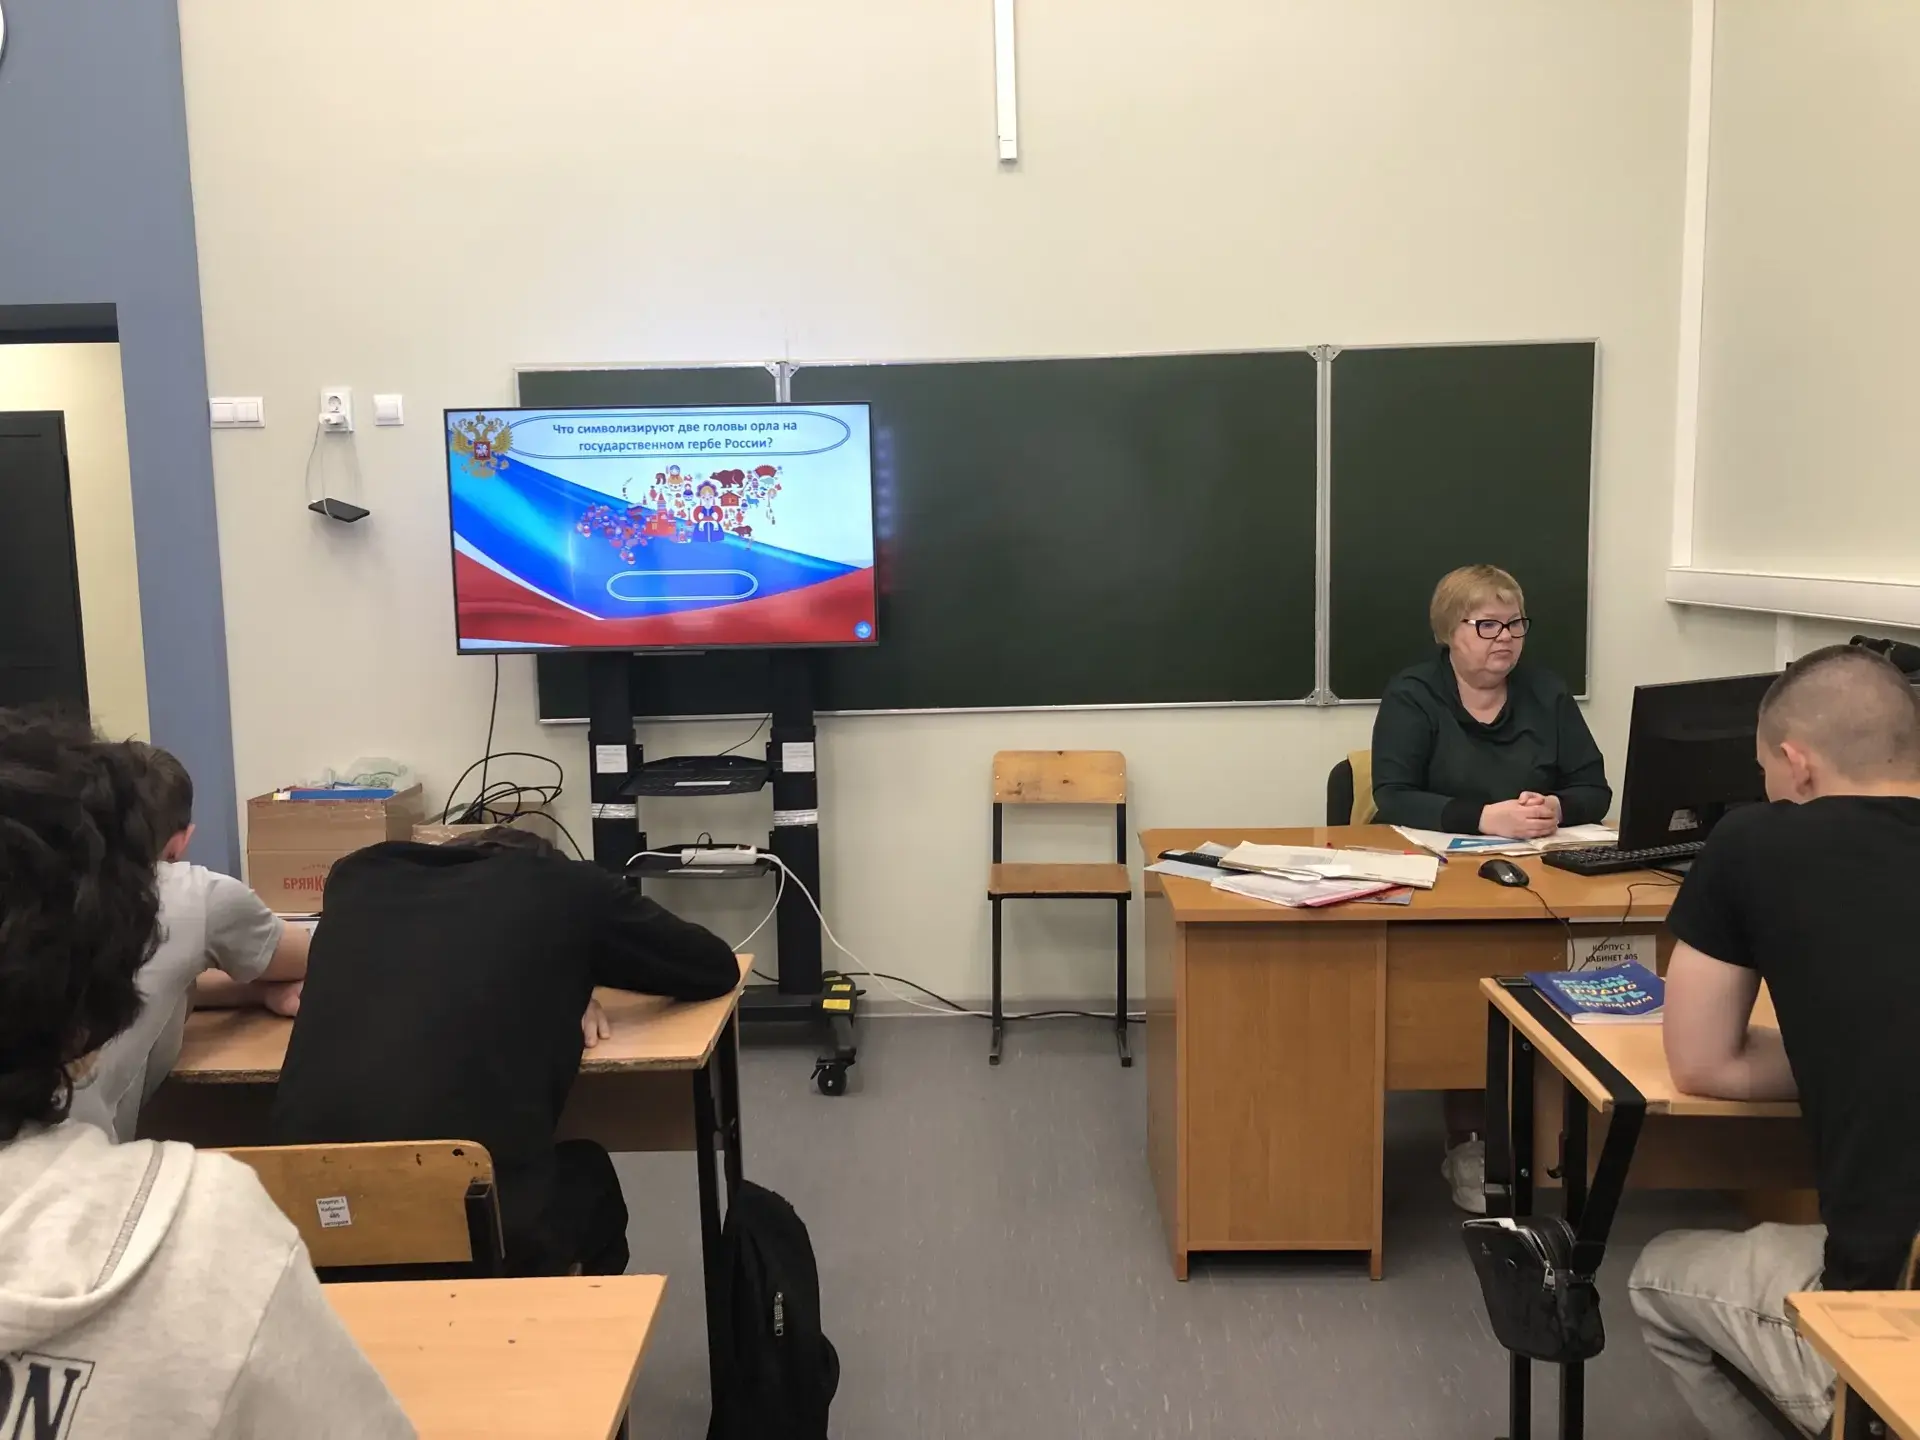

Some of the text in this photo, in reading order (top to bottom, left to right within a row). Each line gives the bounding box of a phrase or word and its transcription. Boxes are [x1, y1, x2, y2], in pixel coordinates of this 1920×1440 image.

[553, 422, 797, 435] Что символизируют две головы орла на
[579, 437, 774, 452] государственном гербе России?
[283, 874, 325, 892] БРЯНК
[1592, 944, 1625, 952] КОРПУС
[1585, 954, 1623, 963] КАБИНЕТ
